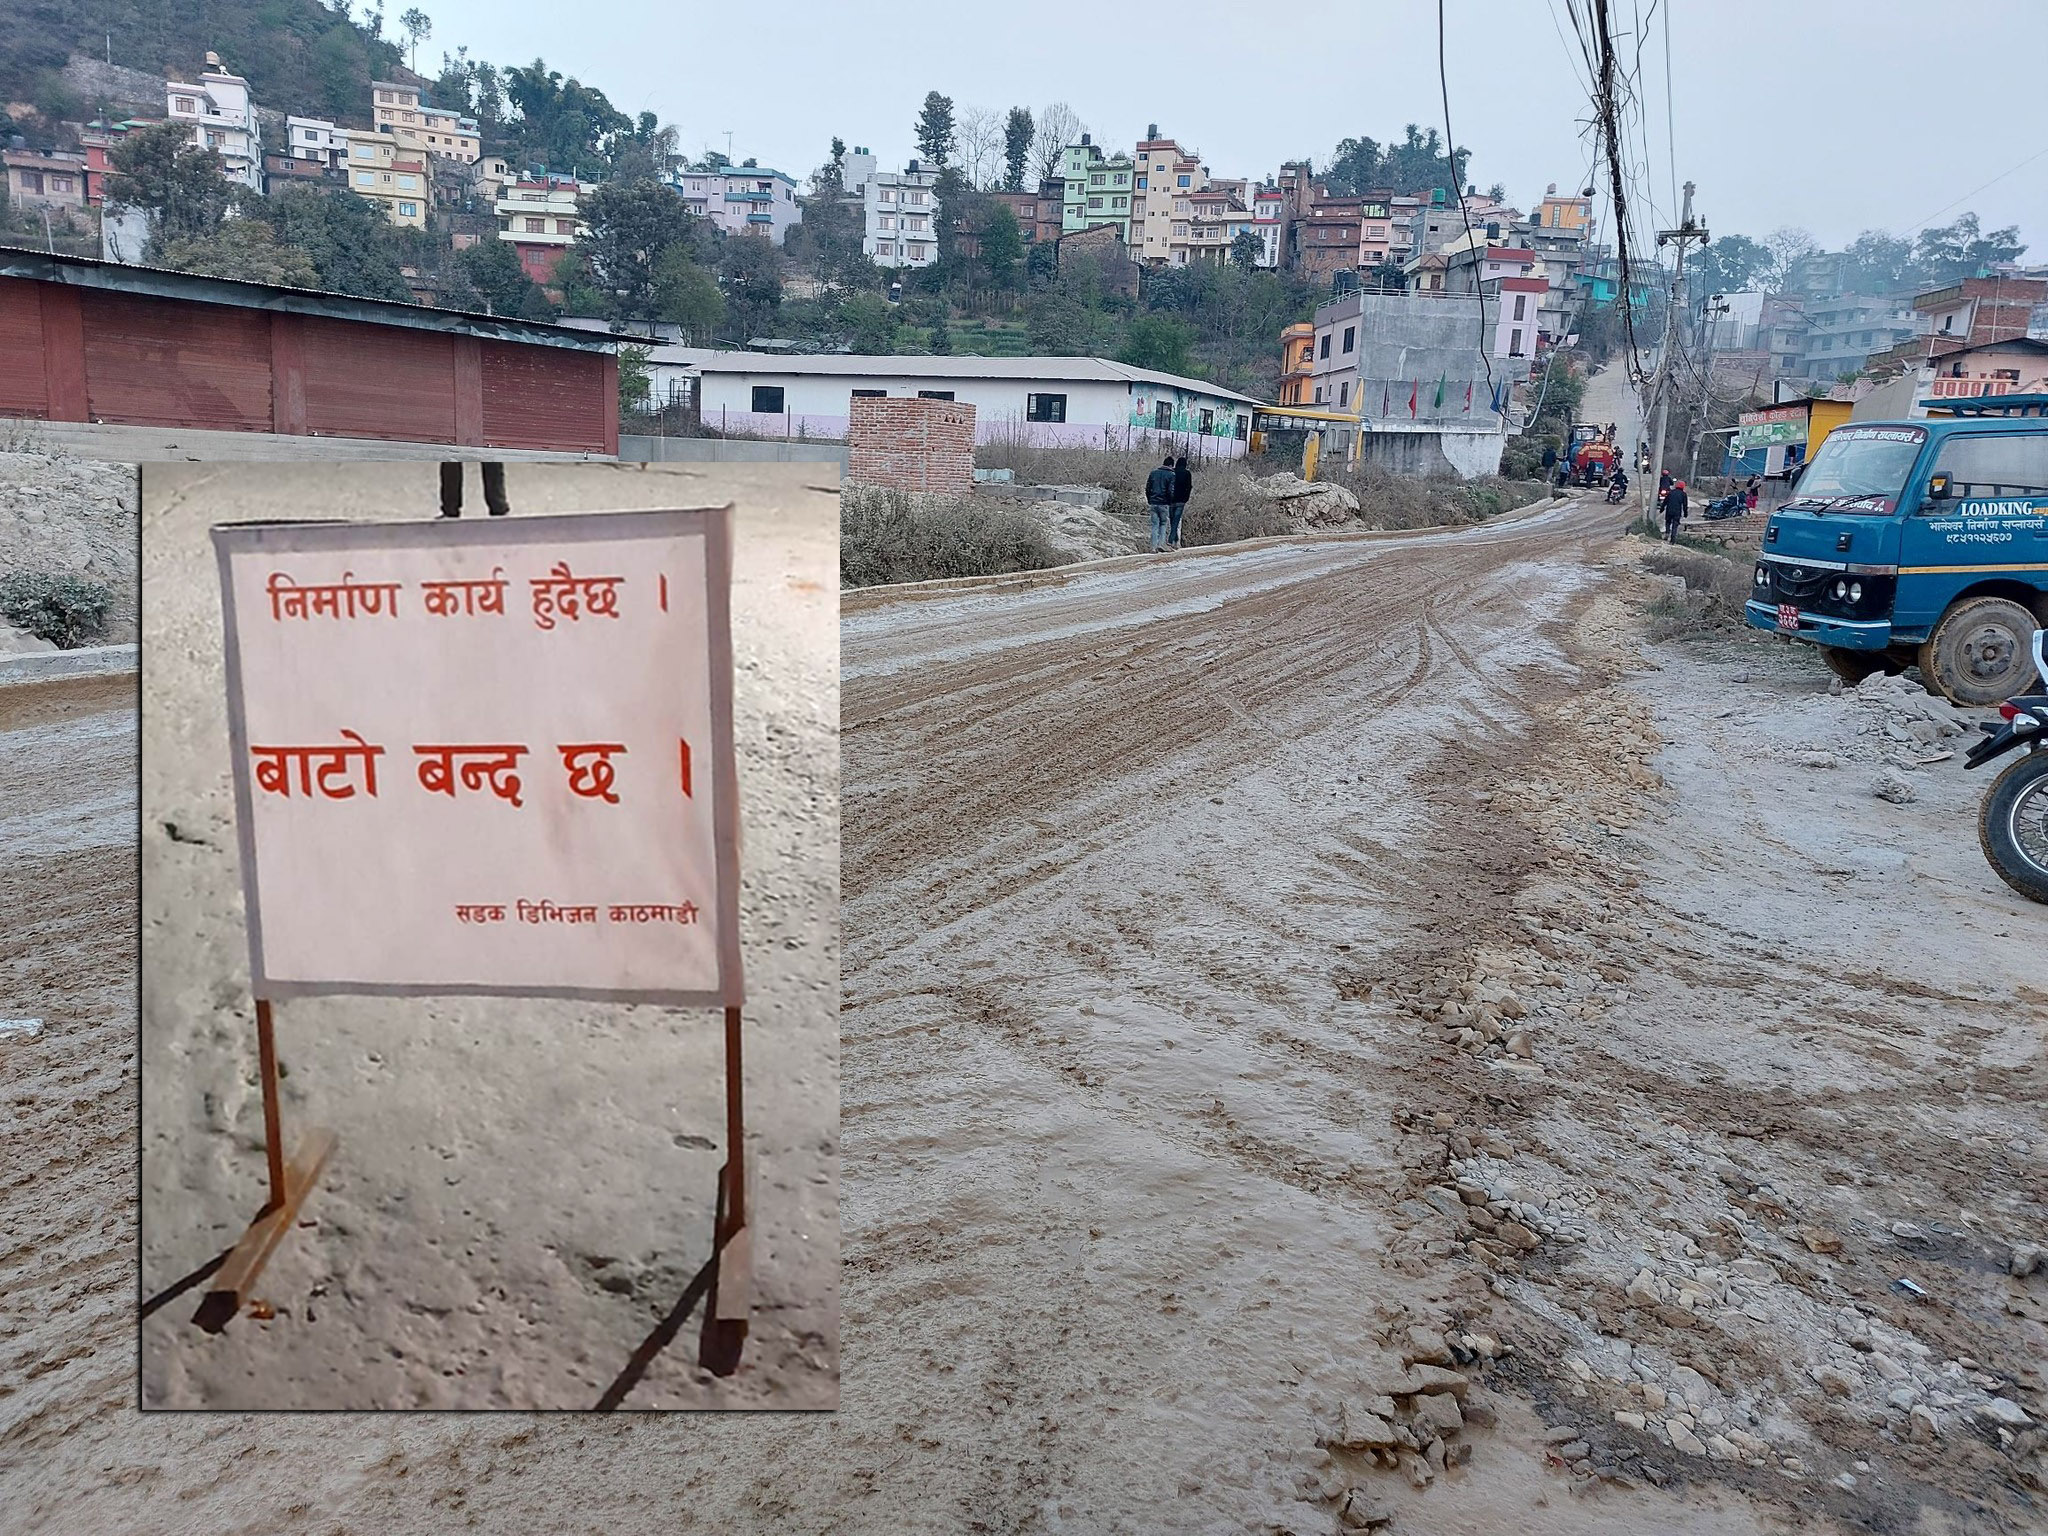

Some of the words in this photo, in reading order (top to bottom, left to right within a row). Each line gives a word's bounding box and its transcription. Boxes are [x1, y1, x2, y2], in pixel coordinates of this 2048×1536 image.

[1961, 501, 2033, 516] LOADKING
[1966, 518, 1999, 531] निर्माण
[2001, 516, 2045, 530] सप्लायर्स
[267, 572, 401, 622] निर्माण
[421, 567, 508, 617] कार्य
[529, 561, 625, 630] हुदैछ
[251, 728, 386, 799] बाटो
[413, 743, 528, 808] बन्द
[557, 743, 627, 804] छ
[456, 904, 507, 924] सडक
[517, 899, 598, 924] डिभिजन
